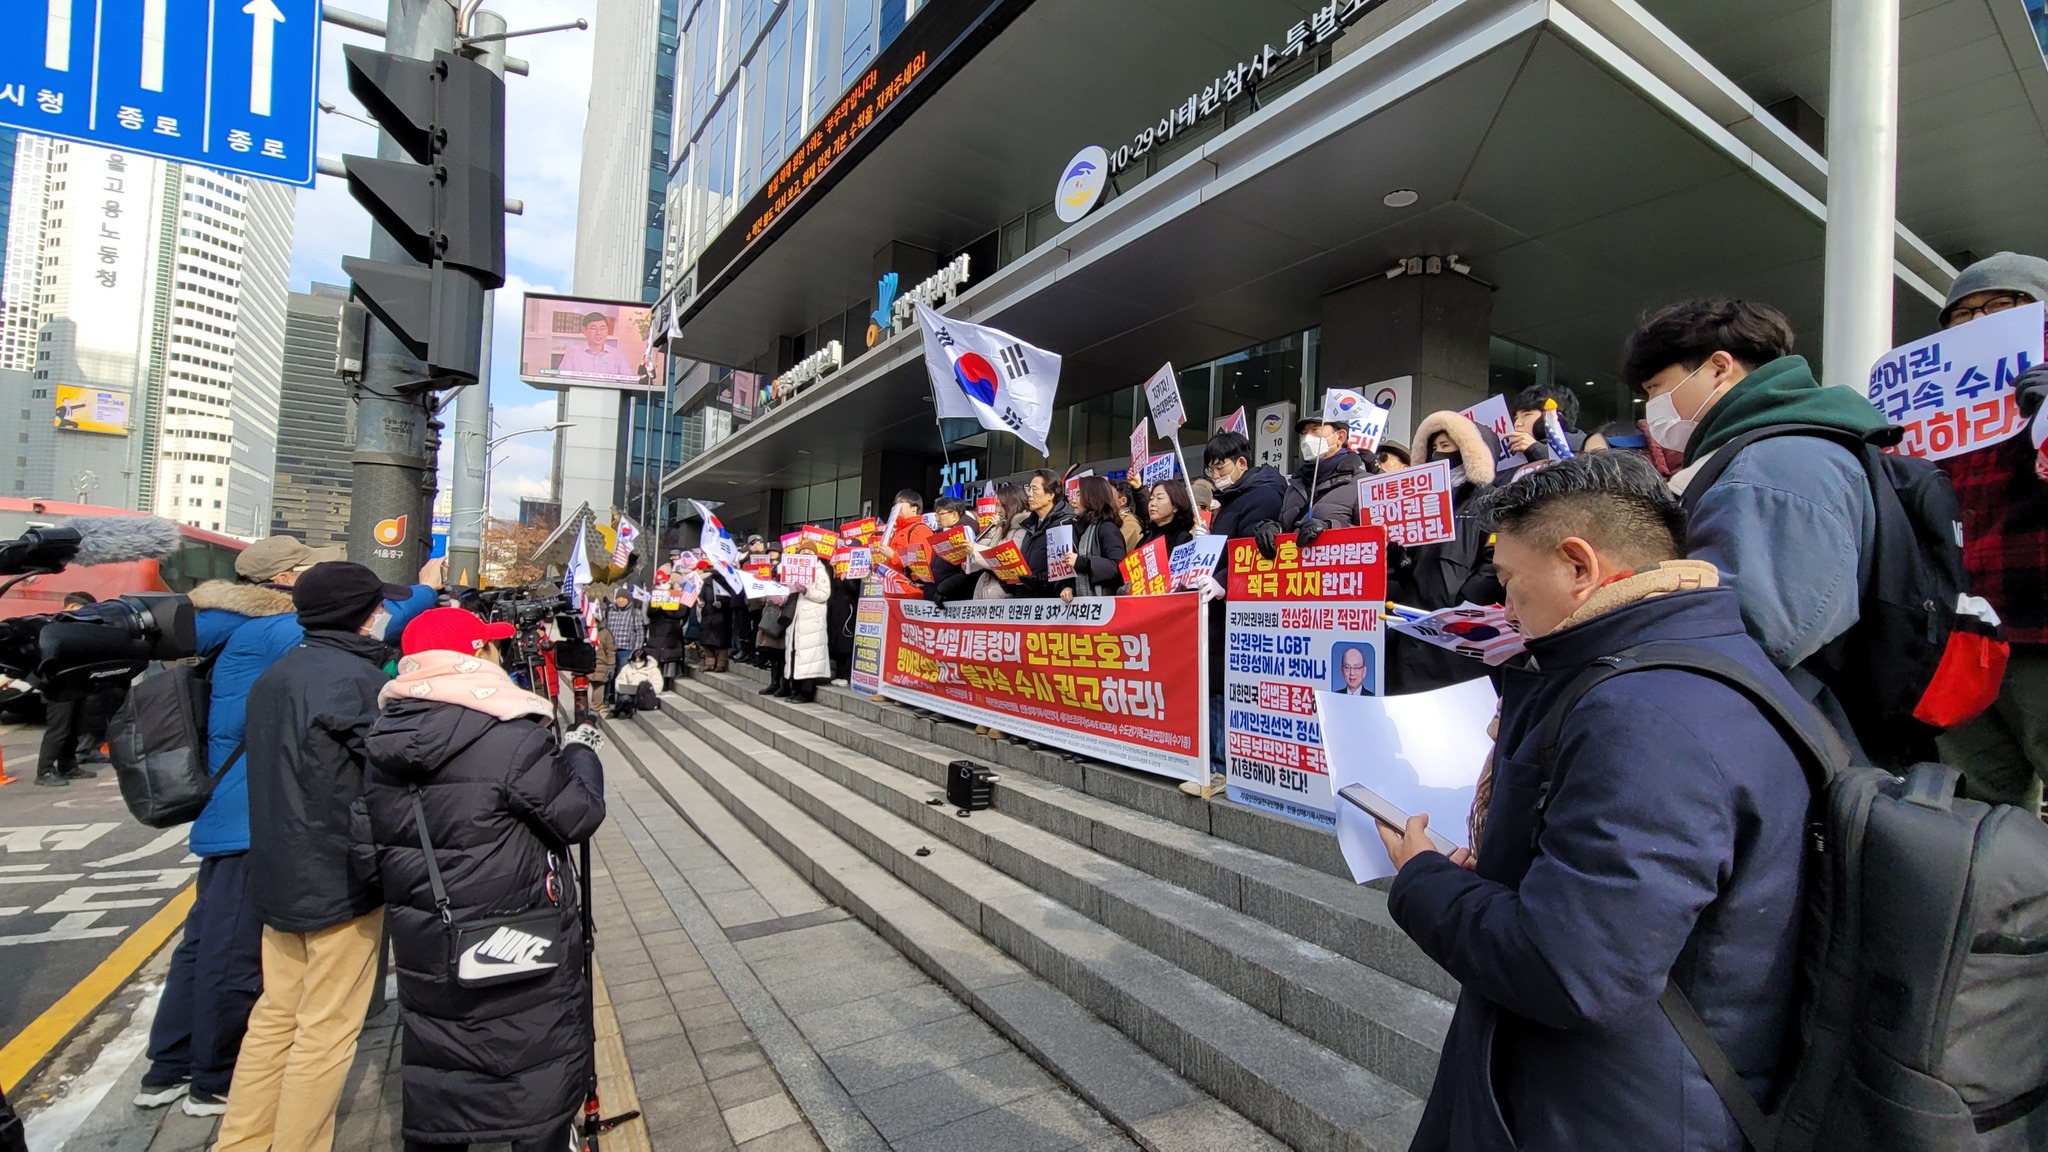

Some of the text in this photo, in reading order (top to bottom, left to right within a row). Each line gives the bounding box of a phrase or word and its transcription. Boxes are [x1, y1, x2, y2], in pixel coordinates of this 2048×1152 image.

[875, 49, 927, 113] 지켜주세요!
[116, 105, 182, 138] 종로
[227, 128, 287, 160] 종로
[1868, 342, 1953, 400] 방어권,
[1955, 350, 2032, 399] 수사
[1146, 453, 1171, 476] 부정선거
[1370, 472, 1434, 503] 대통령의
[1368, 492, 1442, 526] 방어권을
[1386, 516, 1452, 545] 장하라.
[372, 548, 405, 560] 서울중구
[1191, 553, 1217, 567] 수사
[1301, 541, 1379, 568] 인권위원장
[1247, 570, 1364, 598] 적극 지지한다!
[988, 604, 1005, 620] 한다!
[1008, 604, 1033, 621] 인권위
[1034, 604, 1044, 620] 앞
[1045, 604, 1061, 621] 3차
[1061, 602, 1102, 621] 기자회견
[1230, 608, 1377, 632] 국가인권위원회 정상화시킬 적임자!
[960, 629, 1023, 664] 대통령의
[1026, 631, 1151, 672] 인권보호와
[1229, 632, 1312, 656] 인권위는 LGBT
[1229, 653, 1327, 680] 편향성에서 벗어나
[1014, 668, 1056, 703] 수사
[1053, 674, 1166, 721] 권고하라!
[1229, 682, 1260, 706] 대한민국
[1260, 681, 1290, 711] 헌법을
[1229, 708, 1324, 744] 세계인권선언 정신
[1230, 756, 1309, 794] 지향해야 한다!
[476, 925, 553, 965] NIKE
